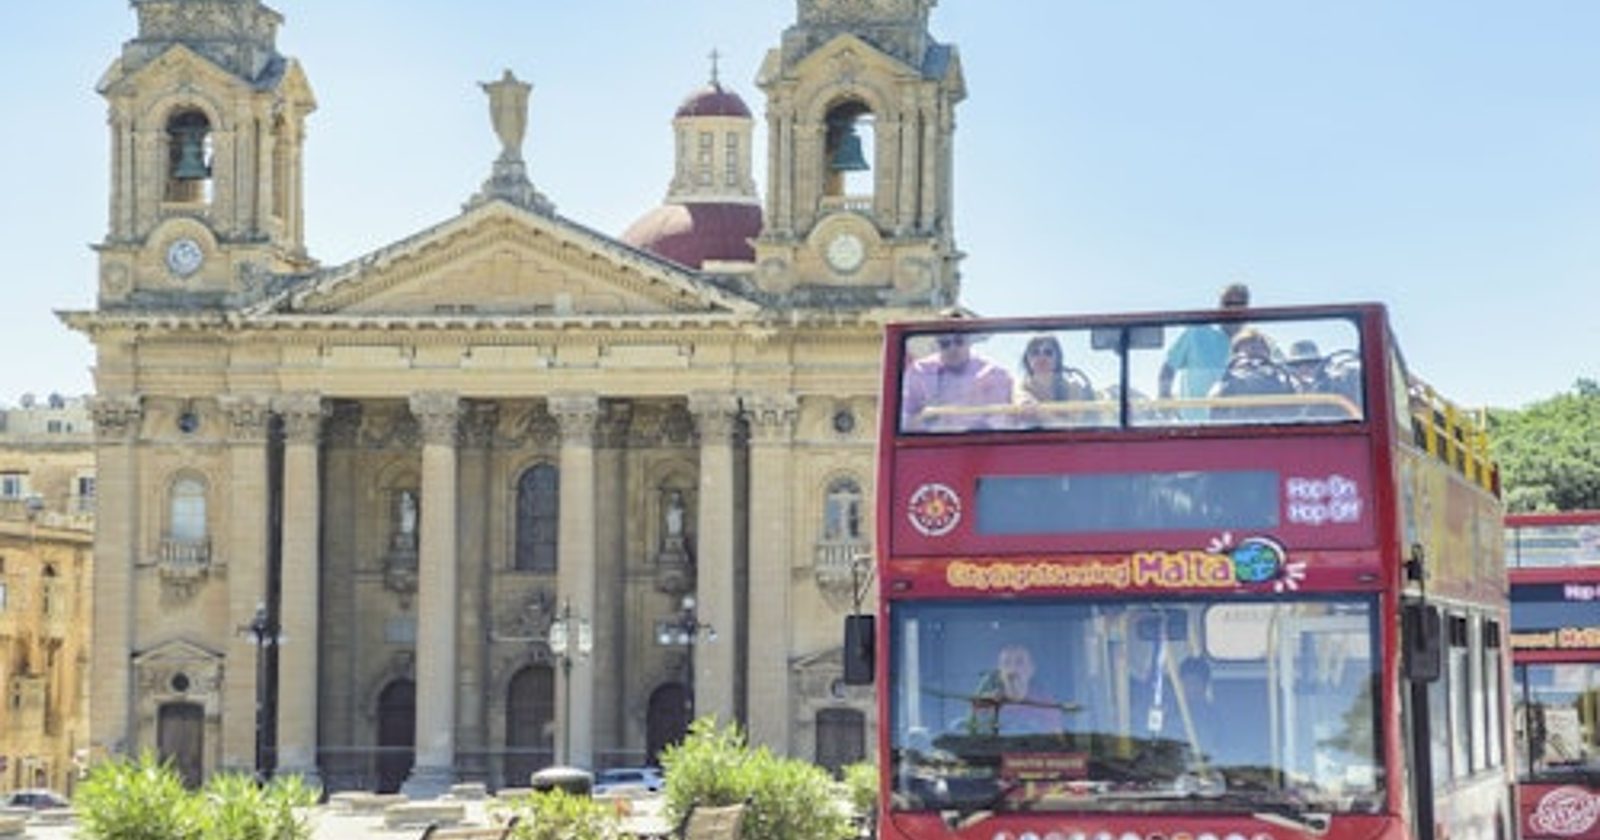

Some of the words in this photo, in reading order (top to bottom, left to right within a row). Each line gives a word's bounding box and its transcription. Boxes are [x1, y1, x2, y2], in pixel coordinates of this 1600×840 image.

[1288, 478, 1326, 501] Hop
[1329, 475, 1357, 497] On
[1288, 501, 1327, 524] Hop
[1329, 500, 1363, 522] Off
[1133, 551, 1235, 587] Malta
